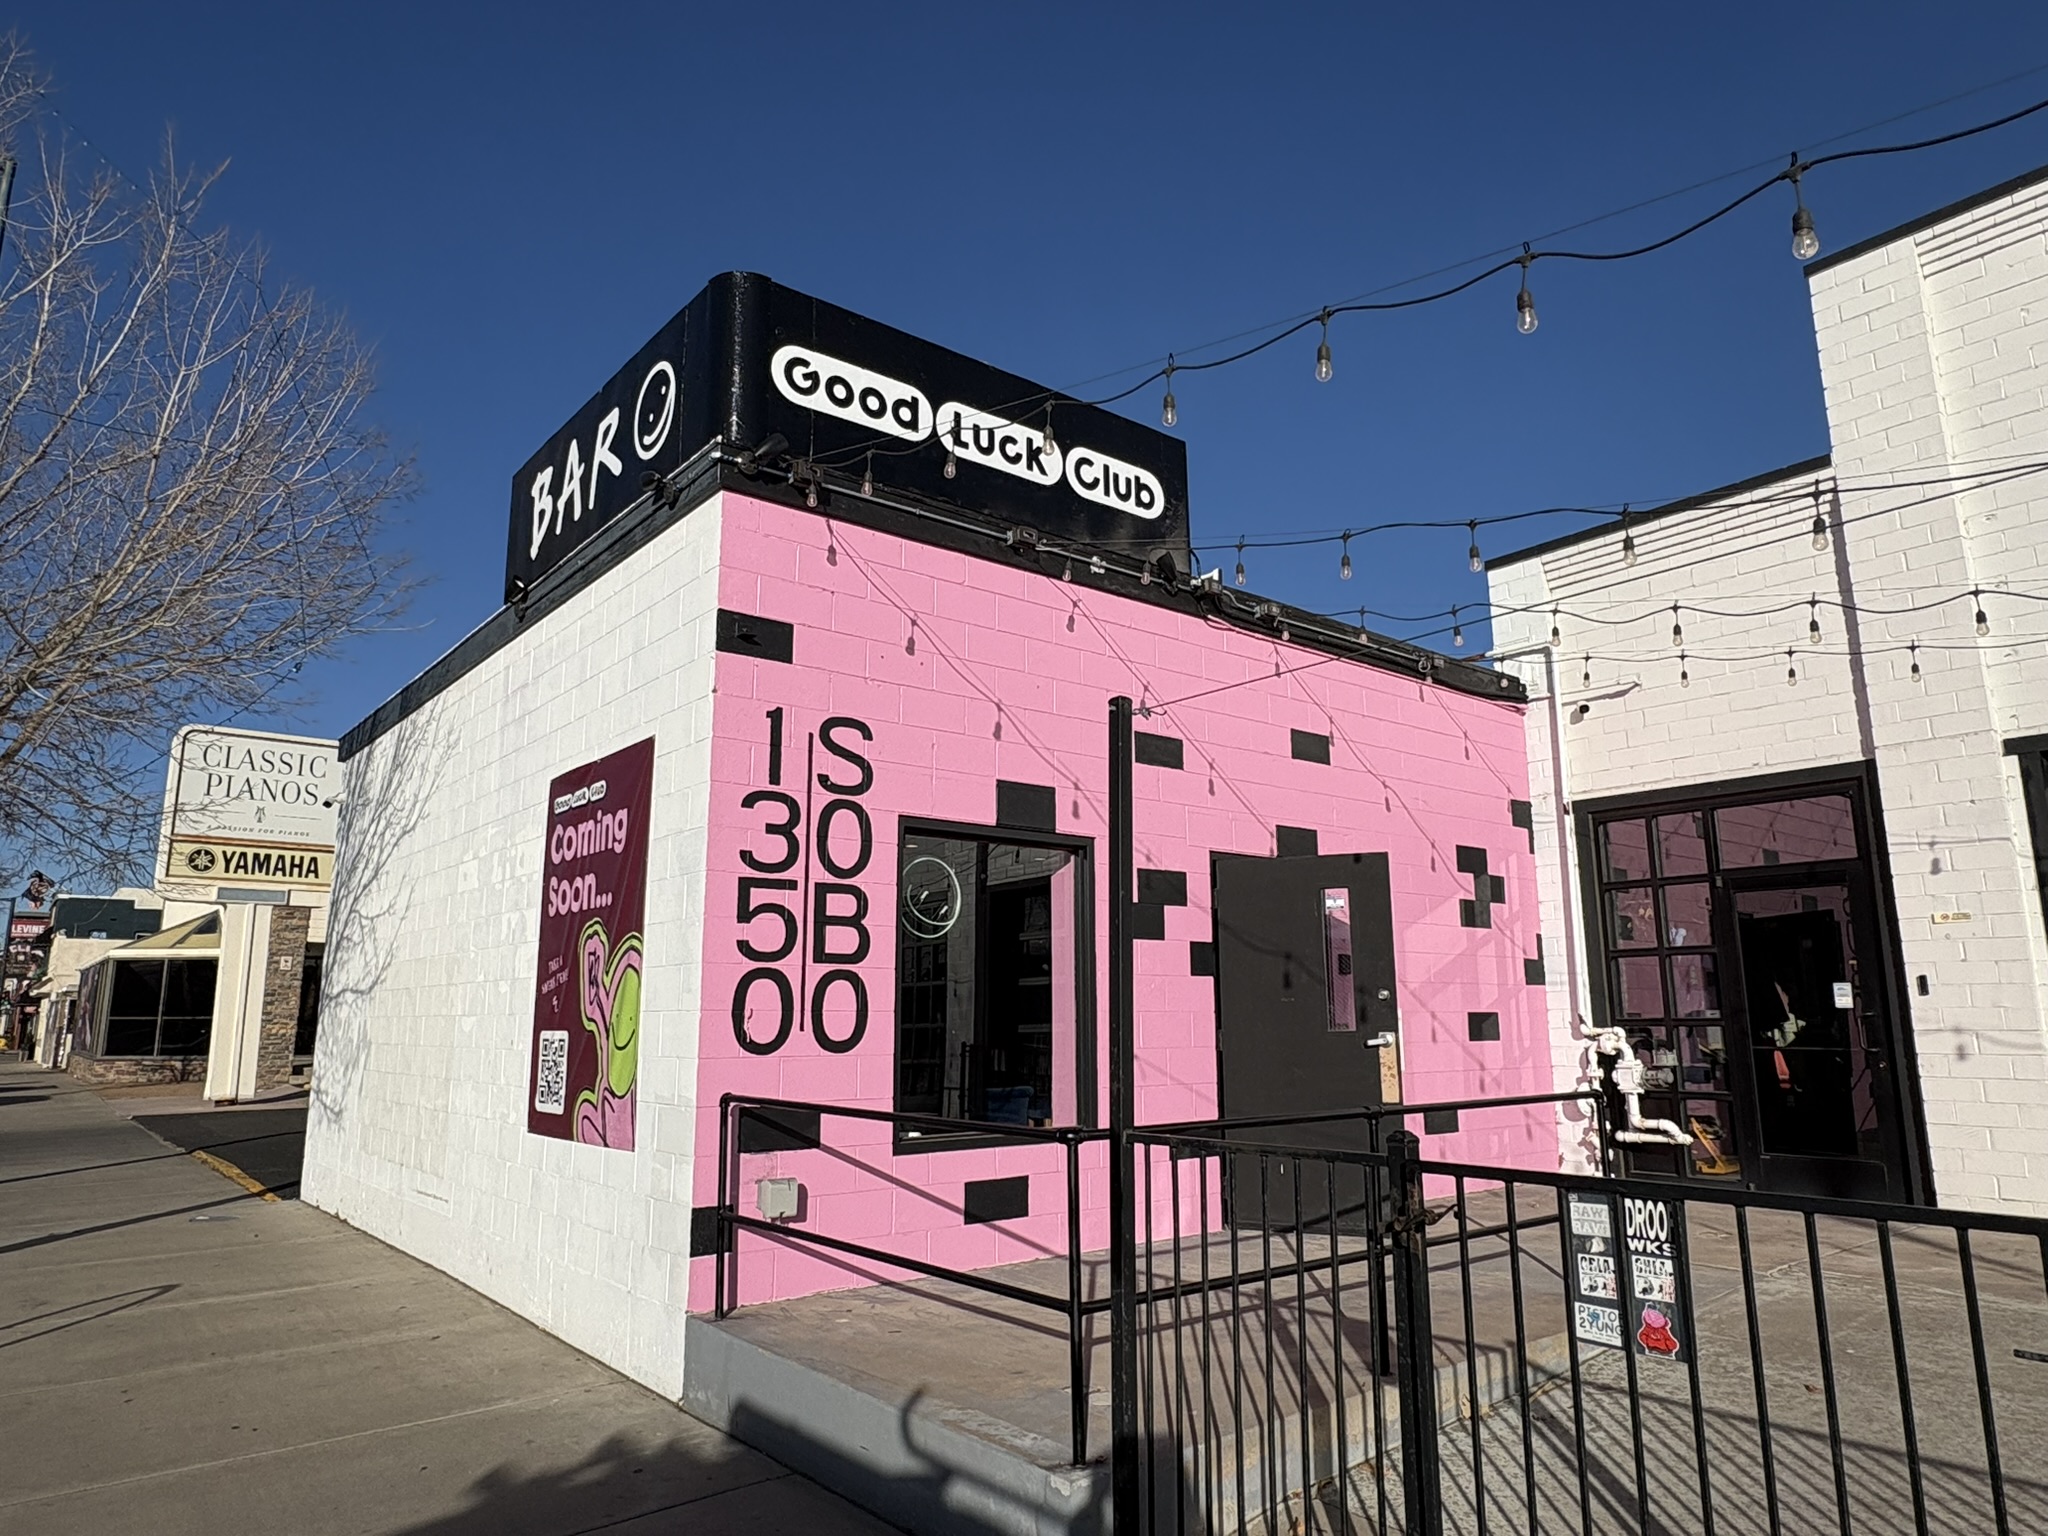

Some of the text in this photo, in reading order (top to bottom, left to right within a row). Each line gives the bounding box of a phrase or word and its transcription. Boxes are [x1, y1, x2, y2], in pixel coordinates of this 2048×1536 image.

[784, 356, 920, 433] Good
[1074, 456, 1156, 511] Club
[530, 407, 623, 560] BAR
[203, 743, 328, 779] CLASSIC
[203, 772, 319, 806] PIANOS
[550, 808, 628, 865] Coming
[222, 850, 320, 879] YAMAHA
[731, 707, 802, 1056] 1350
[11, 924, 46, 934] LEVINE
